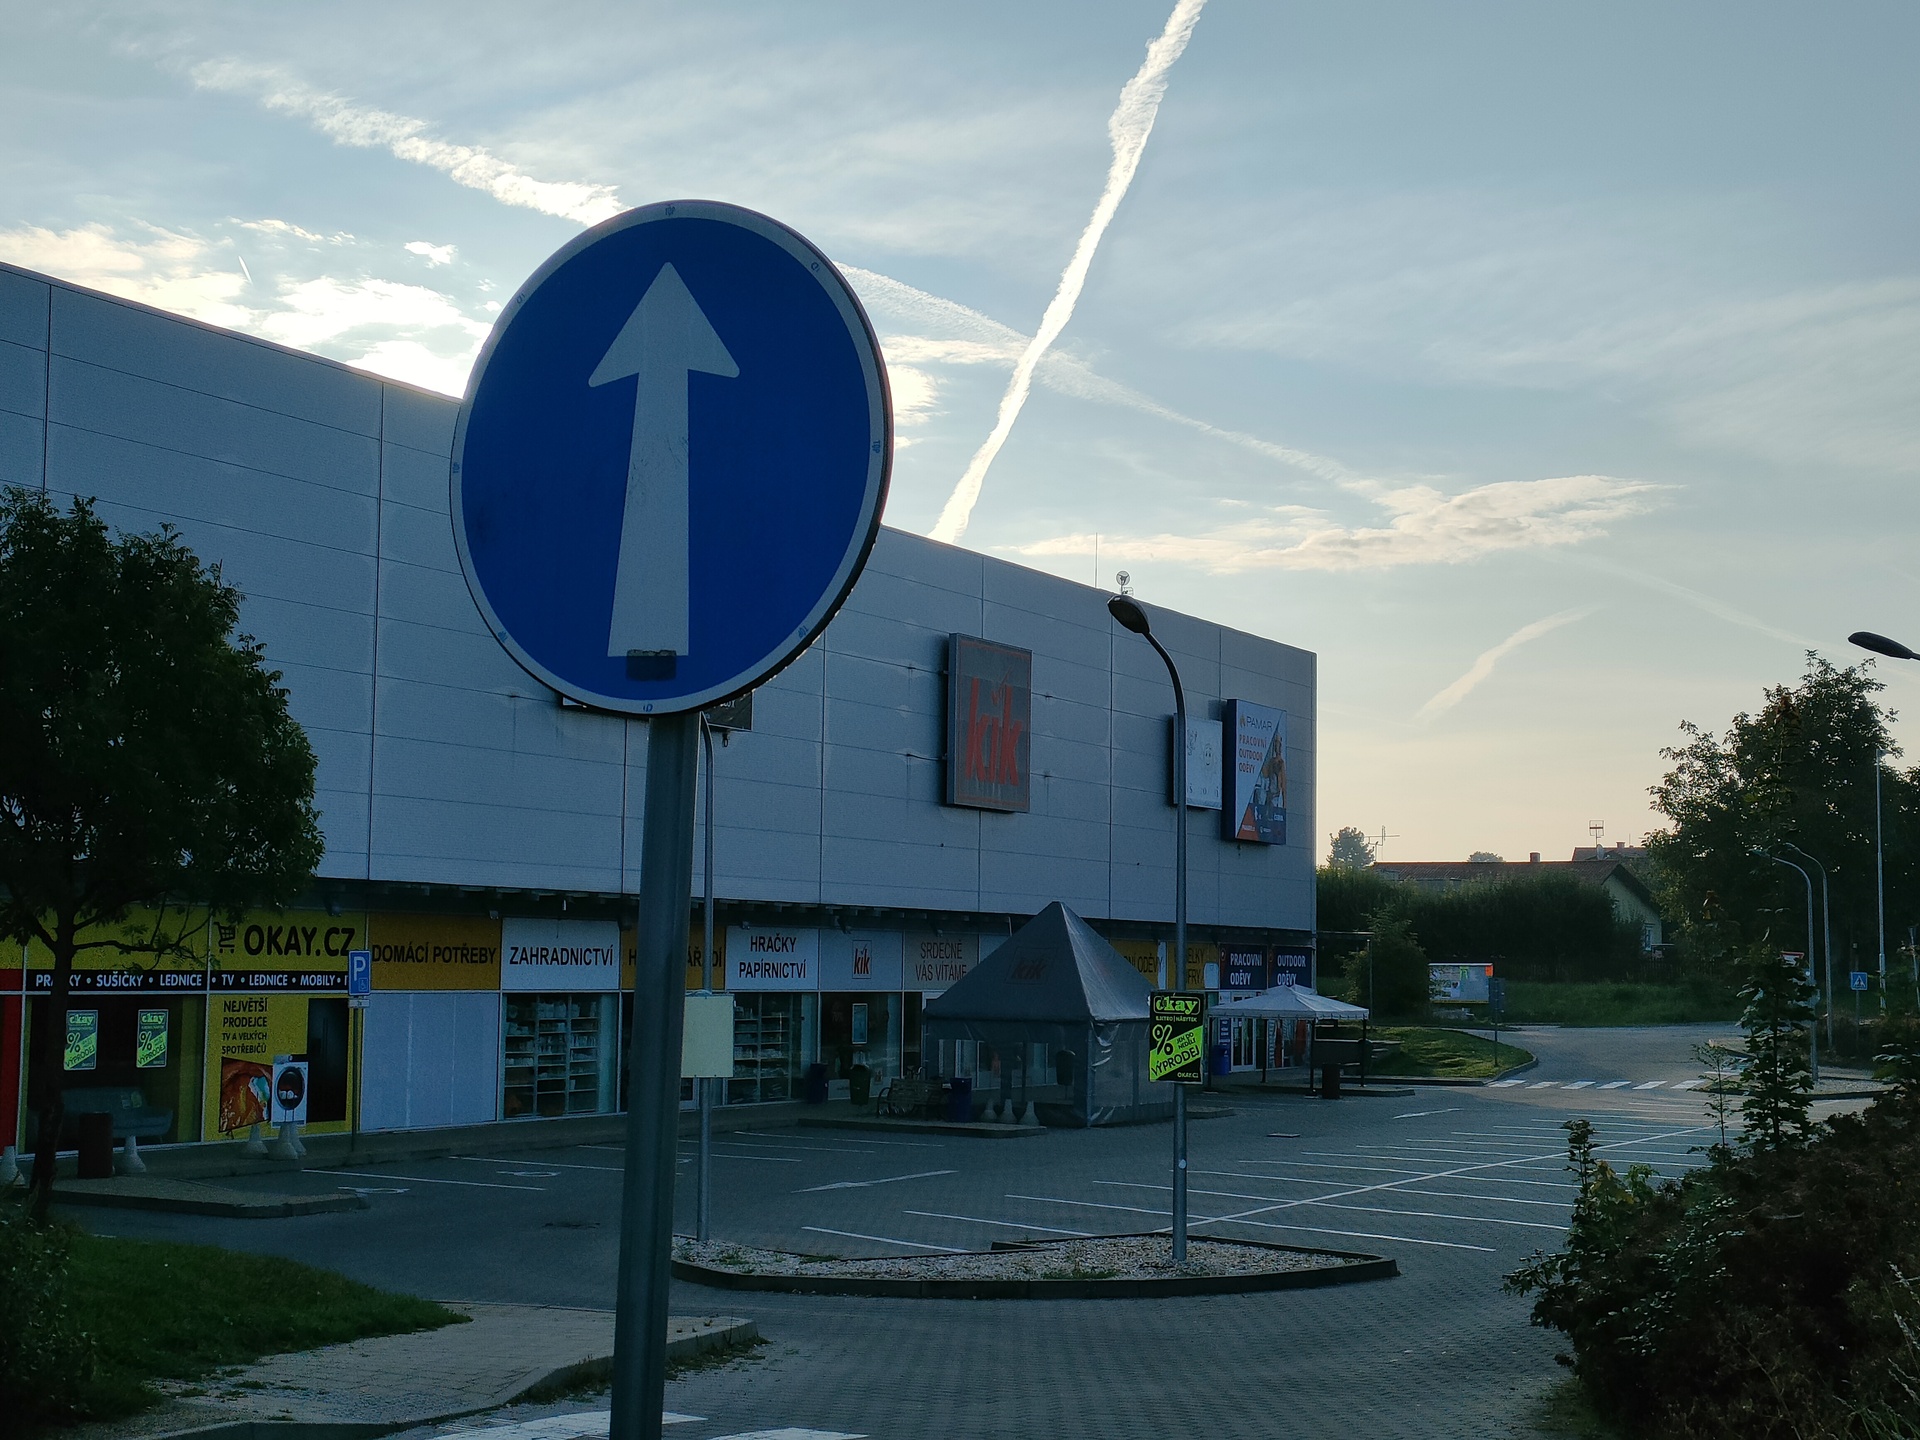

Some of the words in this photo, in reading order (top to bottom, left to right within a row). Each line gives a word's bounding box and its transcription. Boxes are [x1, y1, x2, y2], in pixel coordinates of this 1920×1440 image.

[965, 666, 1023, 787] kik
[1246, 715, 1273, 730] PAMAR
[1239, 734, 1267, 748] PRACOVNÍ
[1238, 748, 1263, 761] OUTDOOR
[244, 924, 356, 957] OKAY.CZ
[750, 932, 797, 953] HRAČKY
[372, 941, 429, 963] DOMÁCÍ
[433, 943, 497, 964] POTŘEBY
[509, 945, 614, 966] ZAHRADNICTVÍ
[853, 943, 871, 975] kik
[1229, 951, 1263, 967] PRACOVNÍ
[1276, 954, 1307, 968] OUTDOOR
[353, 956, 366, 982] P
[739, 958, 807, 979] PAPÍRNICTVÍ
[916, 961, 933, 981] VÁS
[35, 973, 82, 987] PRKY
[95, 971, 144, 988] SUŠIČKY
[159, 973, 202, 987] LEDNICE
[221, 974, 235, 986] TV
[249, 974, 288, 986] LEDNICE
[300, 974, 336, 986] MOBILY
[1229, 969, 1252, 986] ODĚVY
[1276, 969, 1297, 986] ODĚVY
[223, 997, 268, 1013] NEJVĚTŠÍ
[223, 1016, 268, 1028] PRODEJCE
[222, 1032, 231, 1041] TV
[231, 1033, 237, 1041] A
[238, 1030, 268, 1041] VELKÝCH
[222, 1043, 267, 1055] SPOTŘEBIČŮ
[1151, 1045, 1200, 1076] VÝPRODEJ
